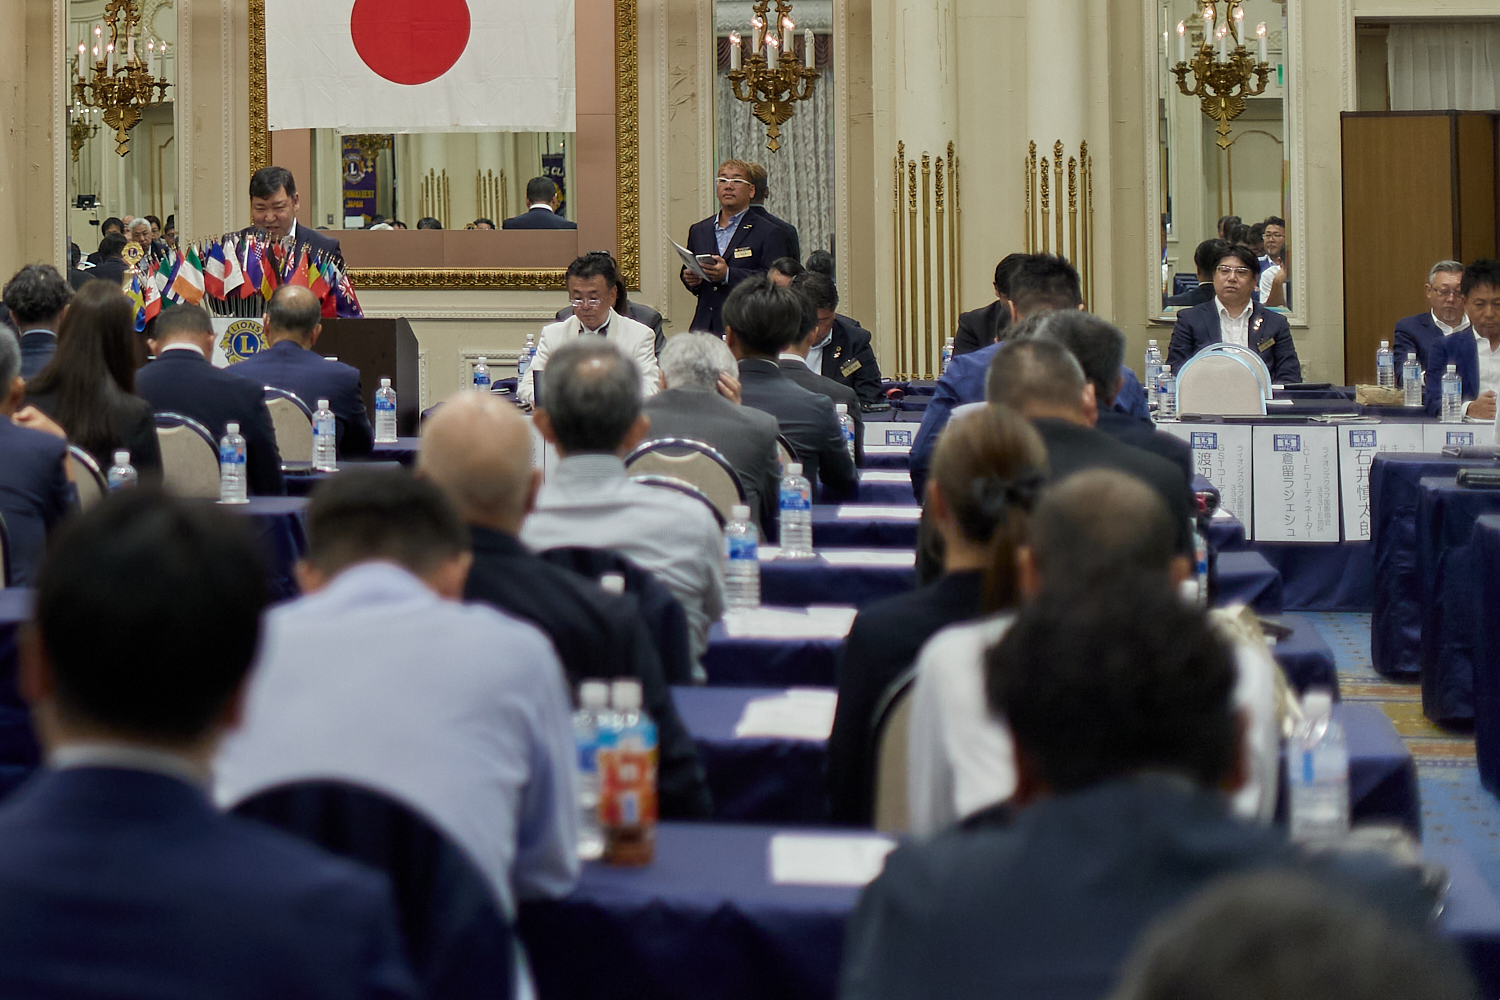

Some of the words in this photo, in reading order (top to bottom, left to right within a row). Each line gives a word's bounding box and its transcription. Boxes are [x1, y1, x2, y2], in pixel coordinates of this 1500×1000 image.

[231, 321, 261, 332] LIONS
[240, 335, 254, 354] L
[1199, 437, 1209, 445] 1.5
[1358, 435, 1369, 443] 1.5
[1455, 437, 1465, 445] 1.5
